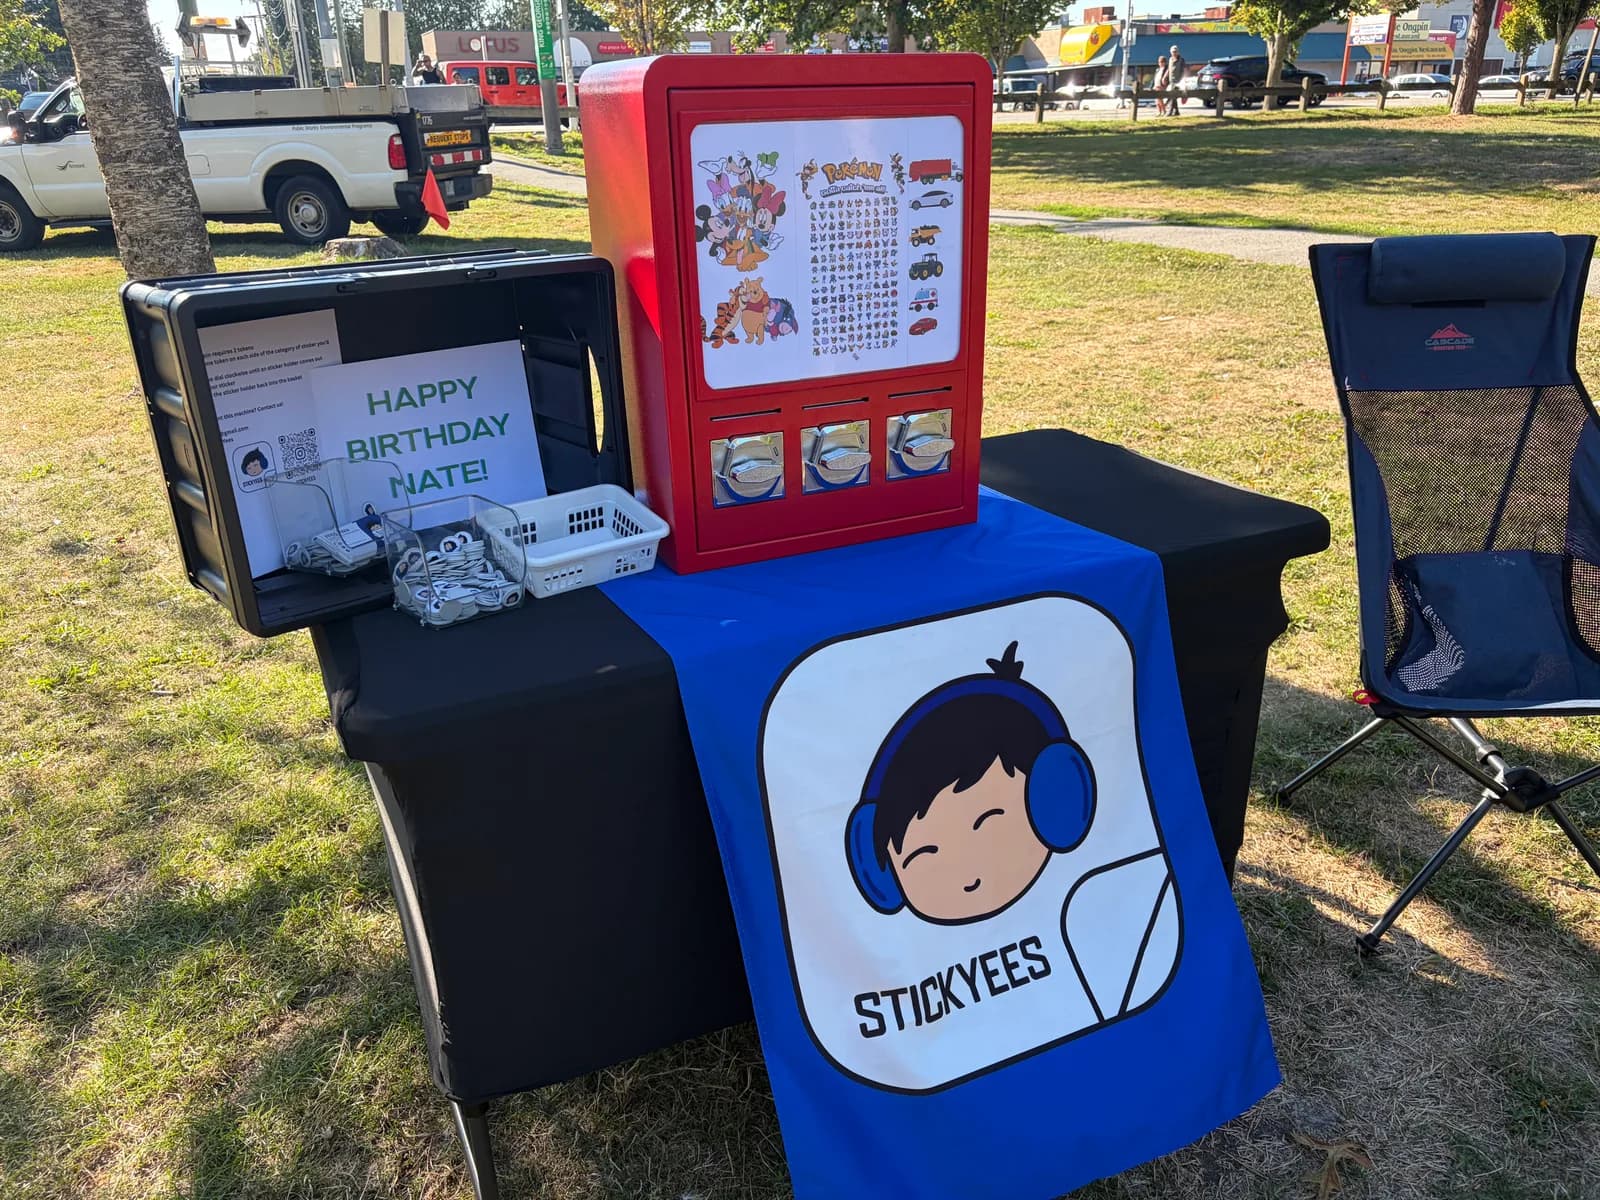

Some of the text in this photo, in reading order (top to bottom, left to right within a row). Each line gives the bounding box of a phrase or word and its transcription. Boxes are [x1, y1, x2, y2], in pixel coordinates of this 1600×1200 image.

[537, 29, 545, 48] KING
[1402, 22, 1429, 33] Ongpin
[256, 403, 276, 411] Contact
[366, 375, 478, 416] HAPPY
[345, 412, 510, 464] BIRTHDAY
[388, 458, 489, 499] NATE!
[853, 935, 1052, 1039] STICKYEES
